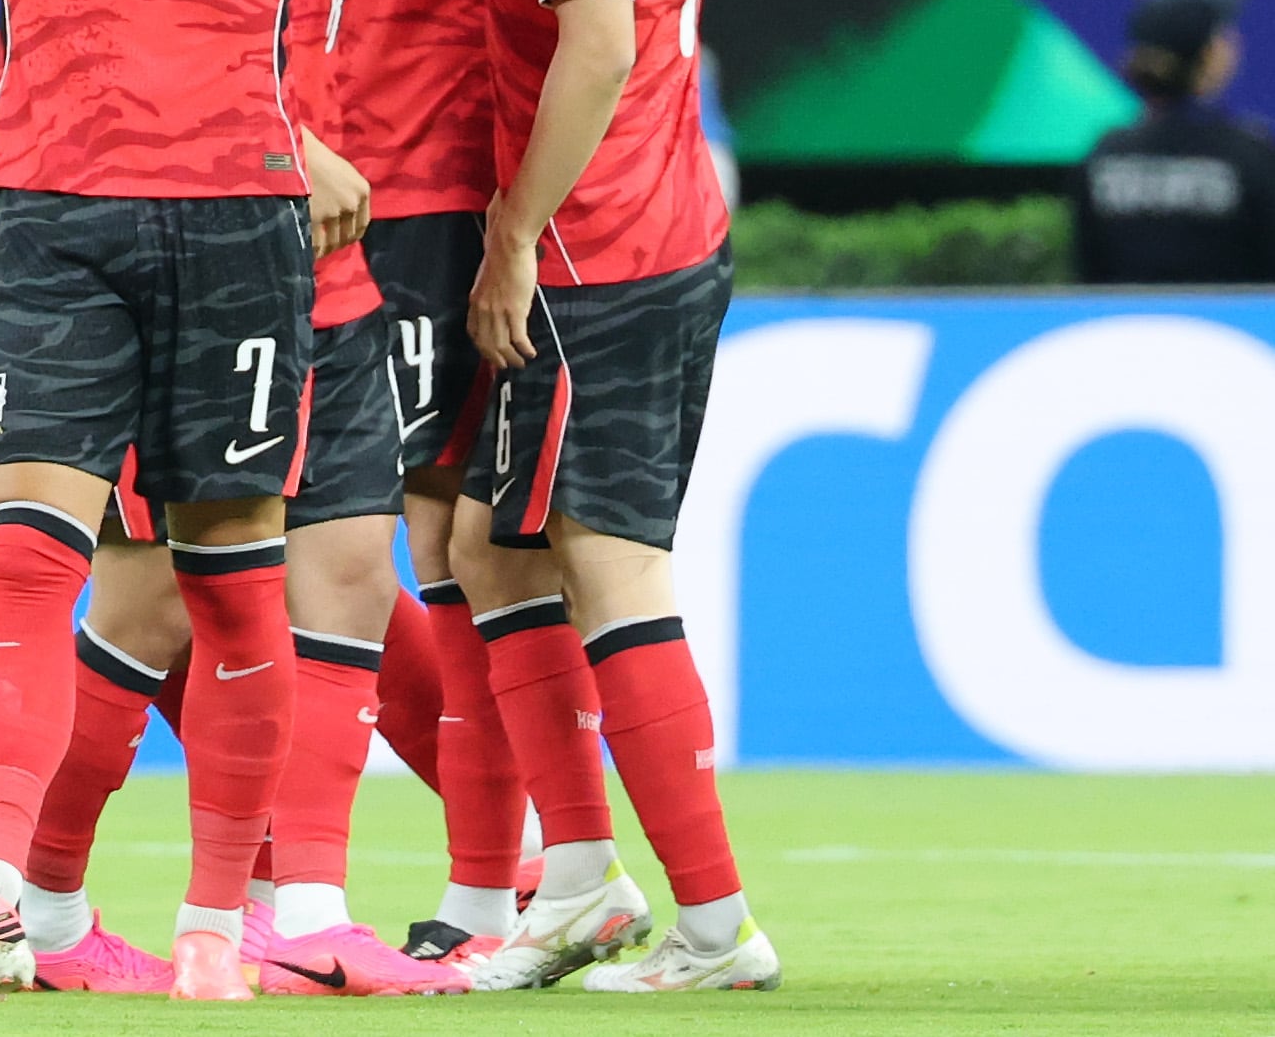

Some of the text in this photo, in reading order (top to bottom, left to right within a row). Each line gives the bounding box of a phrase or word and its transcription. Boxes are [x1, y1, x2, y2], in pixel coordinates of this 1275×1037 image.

[233, 337, 277, 432] 7
[398, 316, 435, 409] 4
[496, 380, 512, 474] 6
